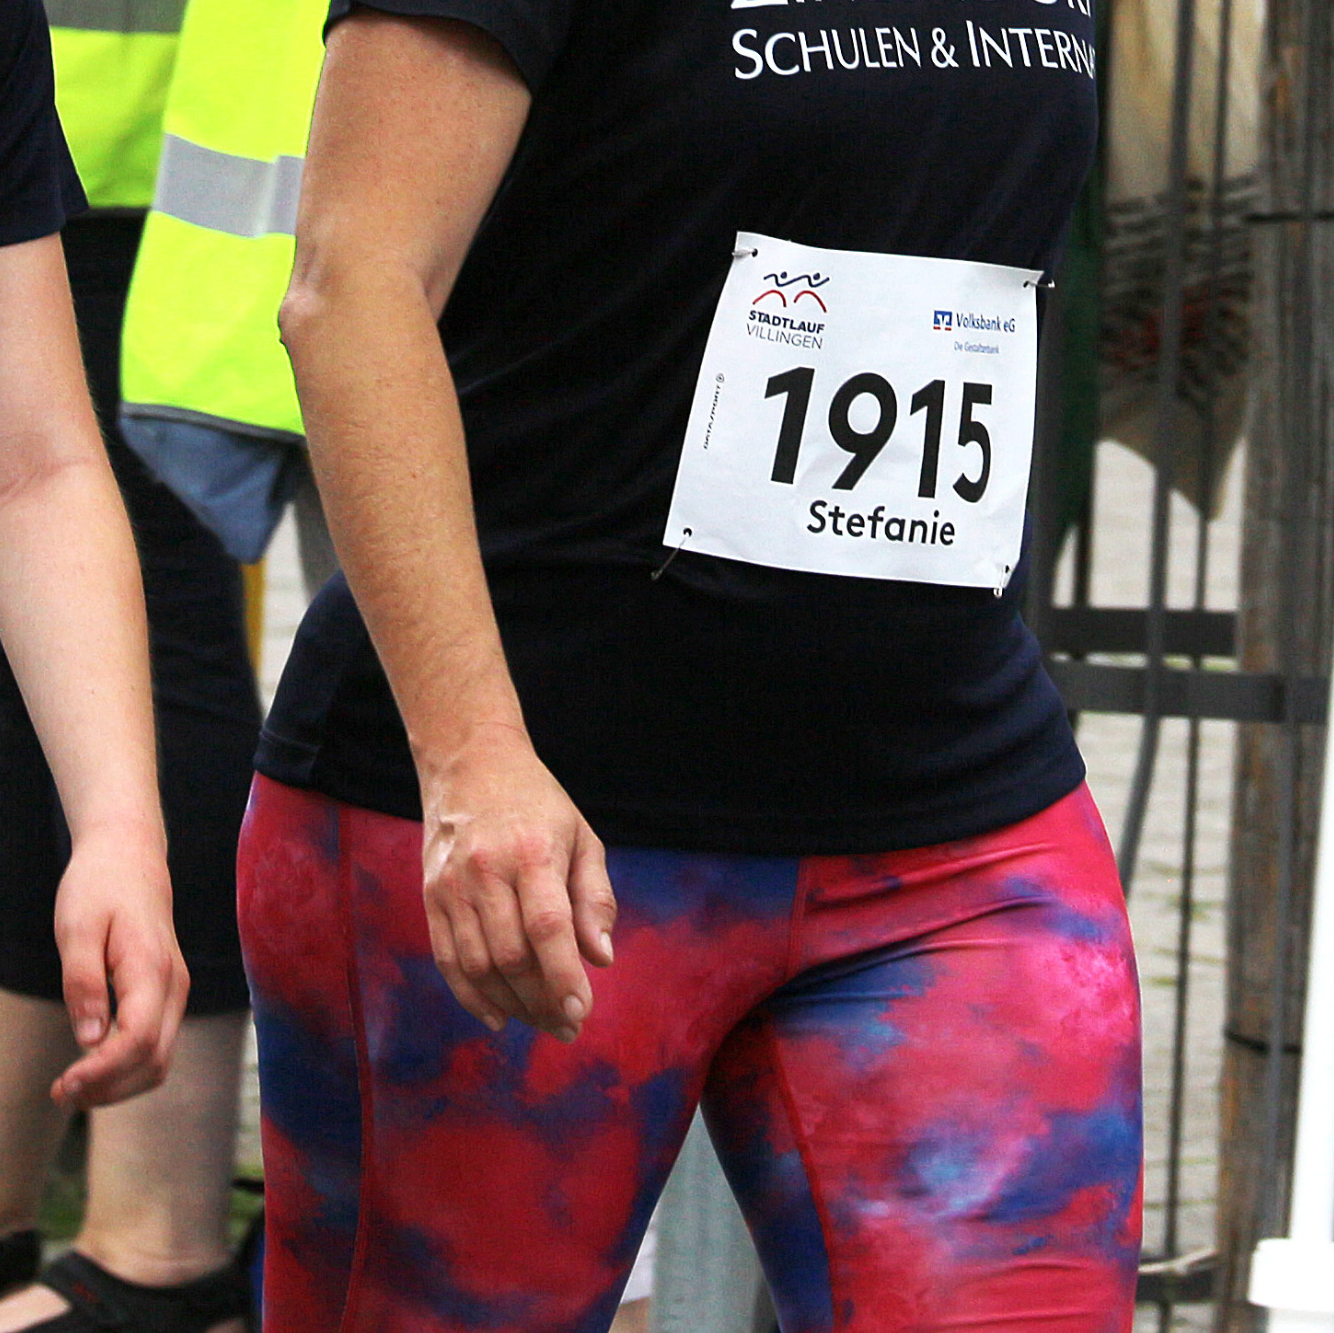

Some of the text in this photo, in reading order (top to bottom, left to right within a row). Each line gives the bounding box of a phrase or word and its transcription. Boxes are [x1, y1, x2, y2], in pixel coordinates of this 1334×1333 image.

[731, 26, 922, 80] SCHULEN
[931, 27, 959, 69] &
[746, 324, 823, 350] VILLINGEN
[748, 310, 826, 335] STADTLAUF
[956, 312, 1016, 333] Volksbank eG
[764, 366, 993, 504] 1915
[806, 499, 956, 547] Stefanie
